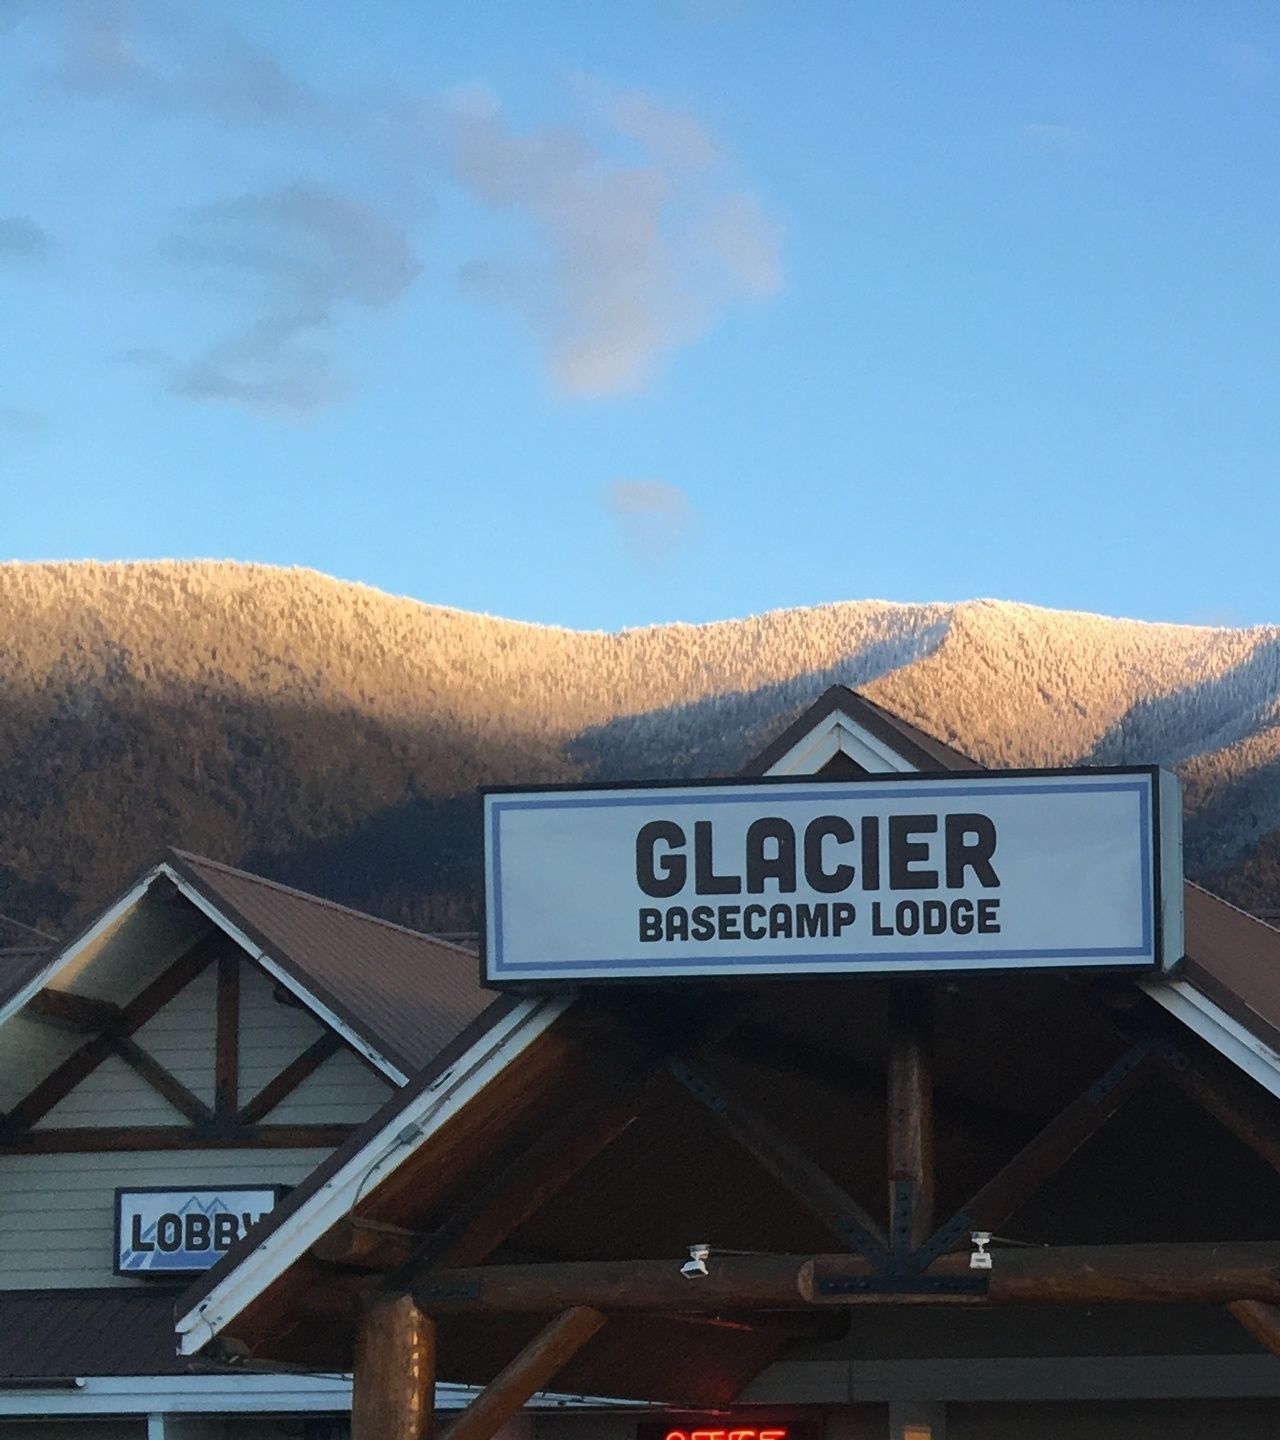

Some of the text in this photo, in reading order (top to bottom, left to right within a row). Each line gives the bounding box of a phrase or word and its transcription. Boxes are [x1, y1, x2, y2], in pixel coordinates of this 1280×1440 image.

[635, 812, 1001, 898] GLACIER
[638, 898, 1001, 943] BASECAMP LODGE
